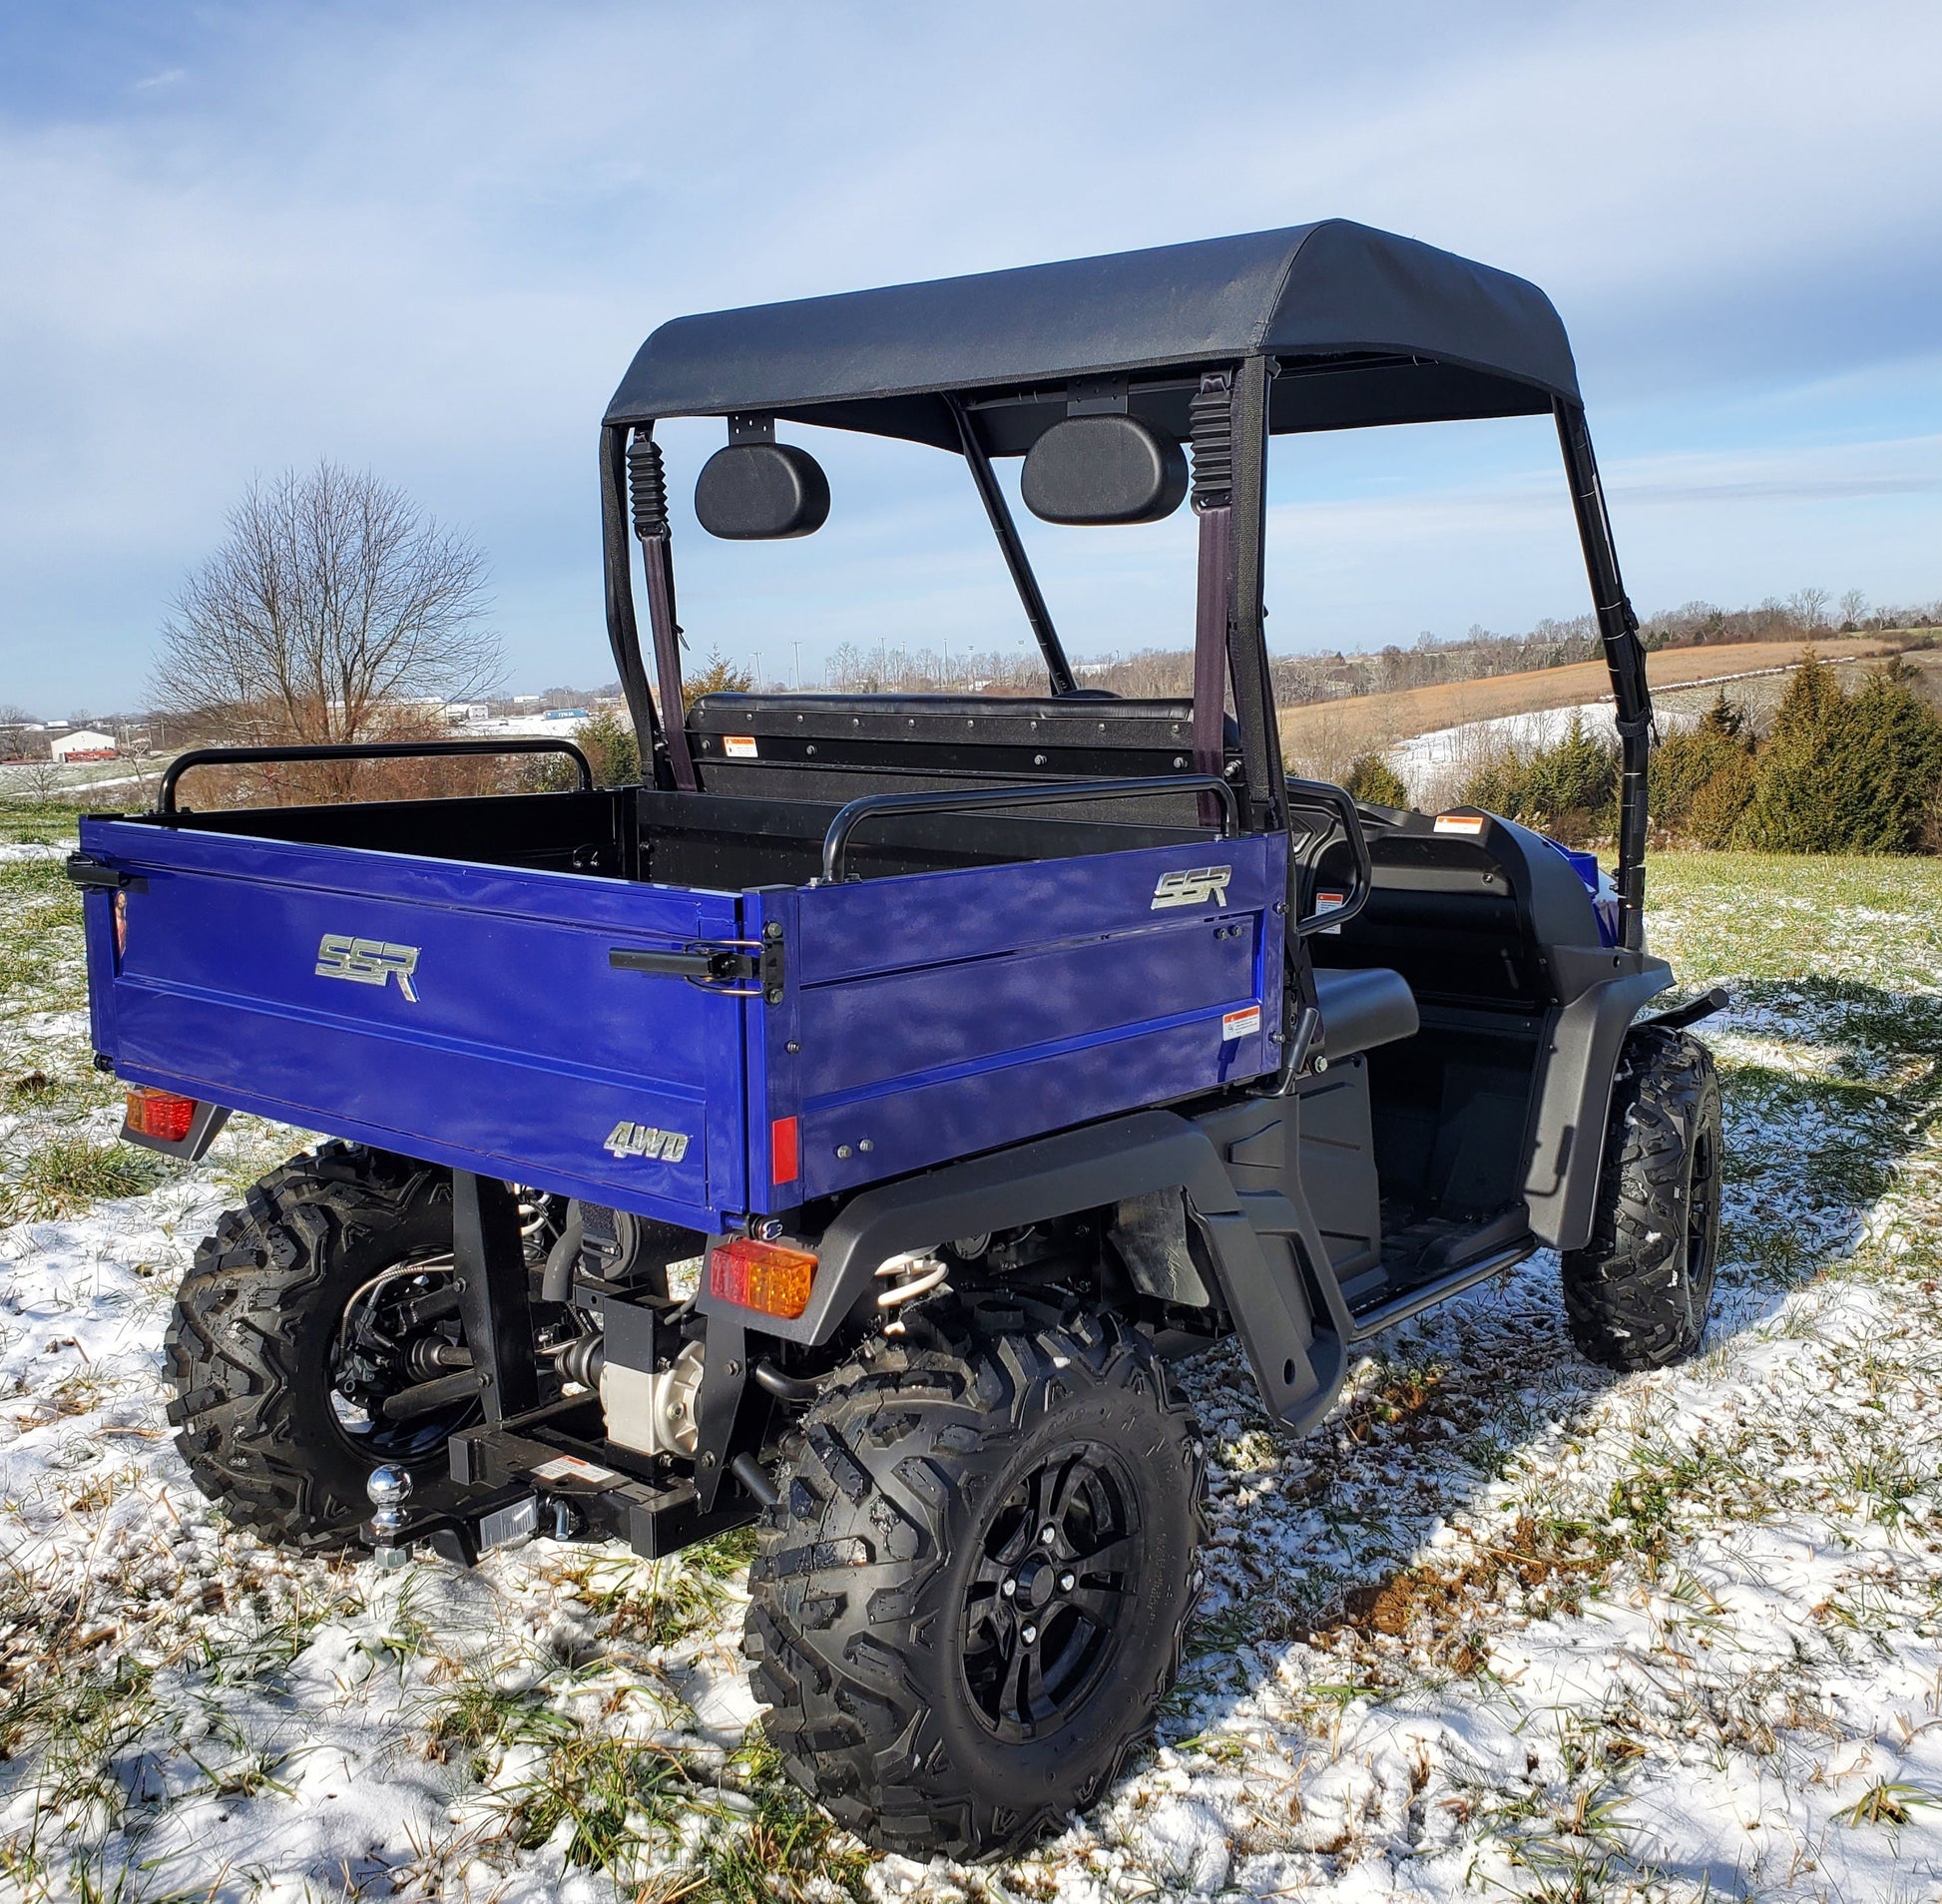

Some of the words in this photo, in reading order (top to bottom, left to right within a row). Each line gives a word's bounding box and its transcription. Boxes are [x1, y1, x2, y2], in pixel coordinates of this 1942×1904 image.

[1151, 865, 1231, 910] SSR
[315, 934, 420, 1003] SSR
[604, 1121, 689, 1163] 4WD
